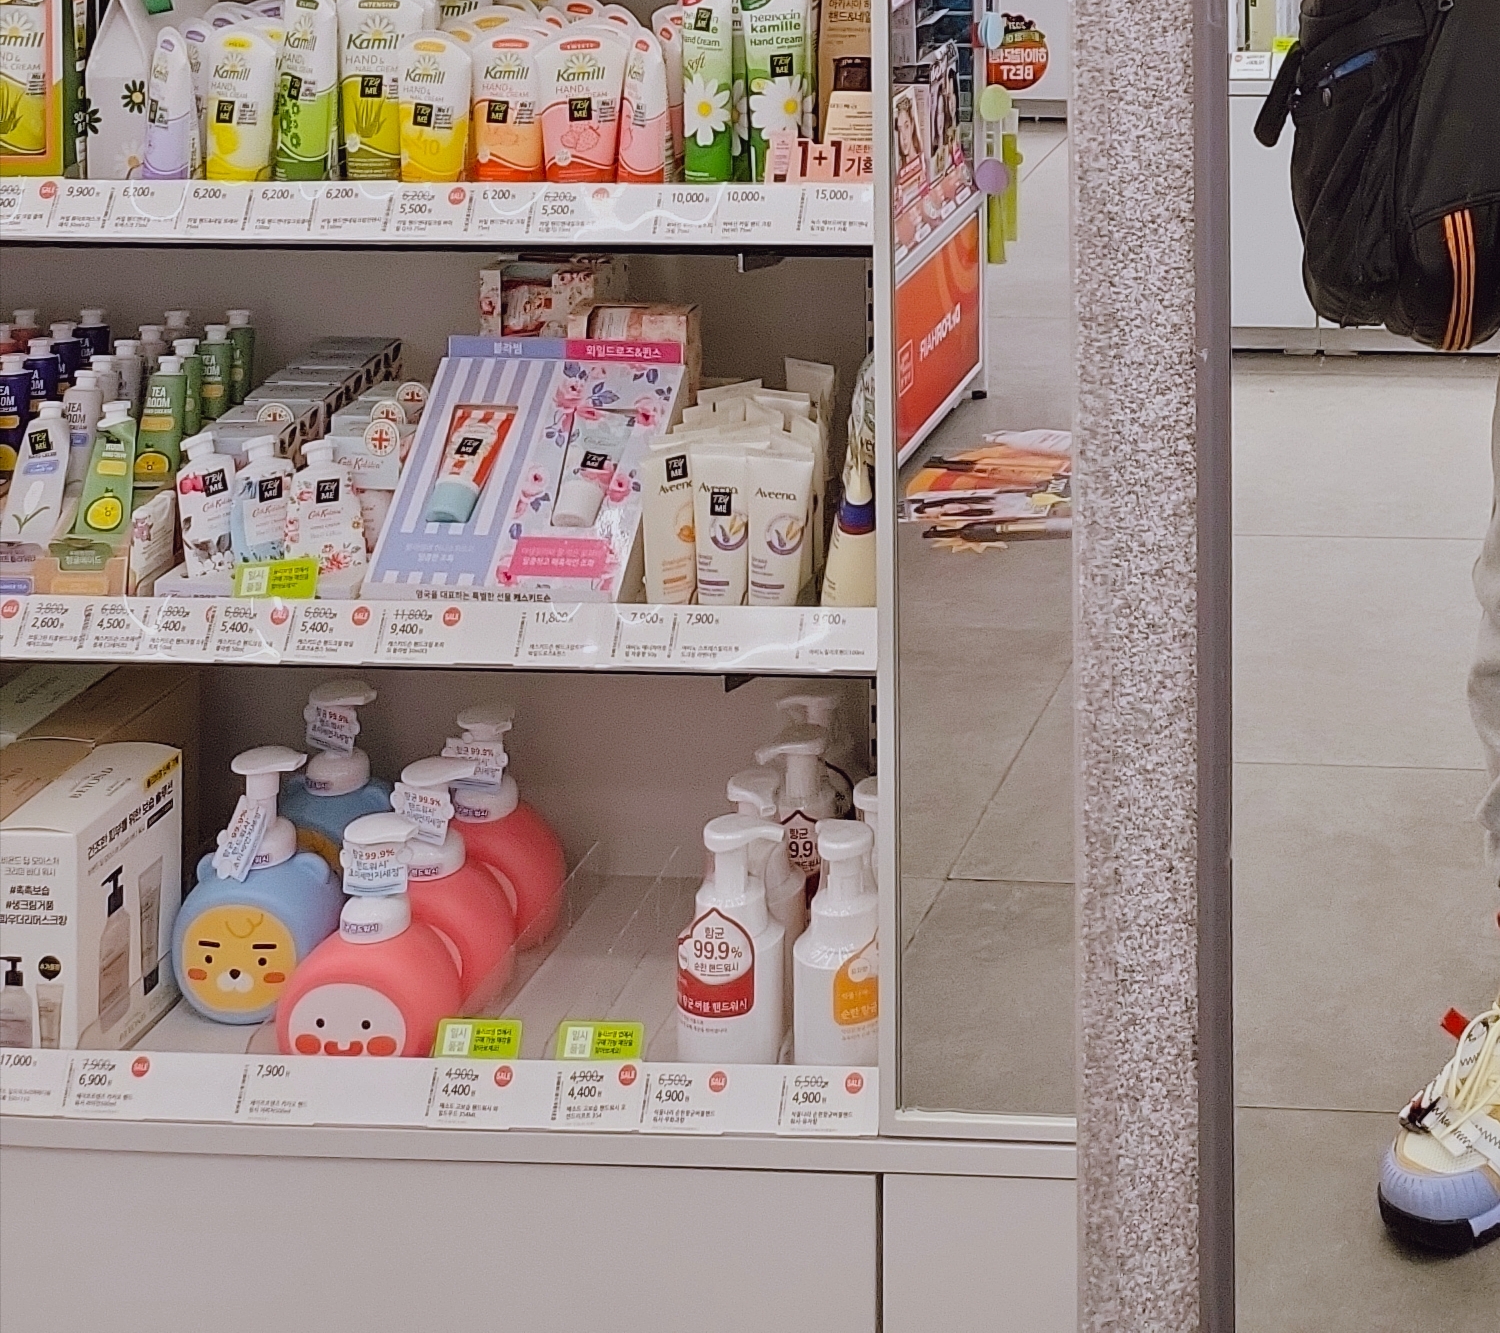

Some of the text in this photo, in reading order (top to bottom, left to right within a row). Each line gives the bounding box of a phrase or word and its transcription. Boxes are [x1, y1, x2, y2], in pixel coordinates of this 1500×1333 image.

[361, 1, 399, 9] INTENSIVE
[751, 20, 801, 34] kamille
[284, 31, 317, 51] Kamill
[347, 34, 404, 50] Kamil
[750, 35, 803, 46] Hand Cream
[346, 56, 376, 65] HAND
[213, 64, 251, 81] Kamill
[405, 71, 445, 84] Kamill
[484, 66, 529, 81] Kamill
[557, 66, 605, 82] Kamill
[556, 85, 583, 95] HAND
[797, 140, 843, 178] 1+1
[151, 386, 167, 397] TEA
[31, 431, 47, 443] TRY
[35, 442, 47, 451] ME
[669, 458, 685, 470] TRY
[205, 471, 223, 484] TRY
[210, 482, 224, 494] ME
[261, 481, 280, 491] TRY
[319, 481, 337, 492] TRY
[264, 489, 278, 498] ME
[320, 491, 335, 500] ME
[712, 494, 730, 504] TRY
[755, 488, 797, 501] Aveeno
[714, 504, 727, 513] ME
[416, 590, 438, 600] 영국을
[440, 590, 470, 600] 대표하는
[472, 592, 495, 601] 특별한
[364, 849, 395, 861] 99.9%
[10, 885, 50, 896] #촉촉보습
[705, 926, 725, 940] 항균
[694, 963, 739, 973] 순한 핸드워시
[712, 997, 748, 1013] 핸드워시
[840, 1007, 859, 1020] 순한
[450, 1024, 467, 1035] 일시
[572, 1027, 588, 1038] 일시
